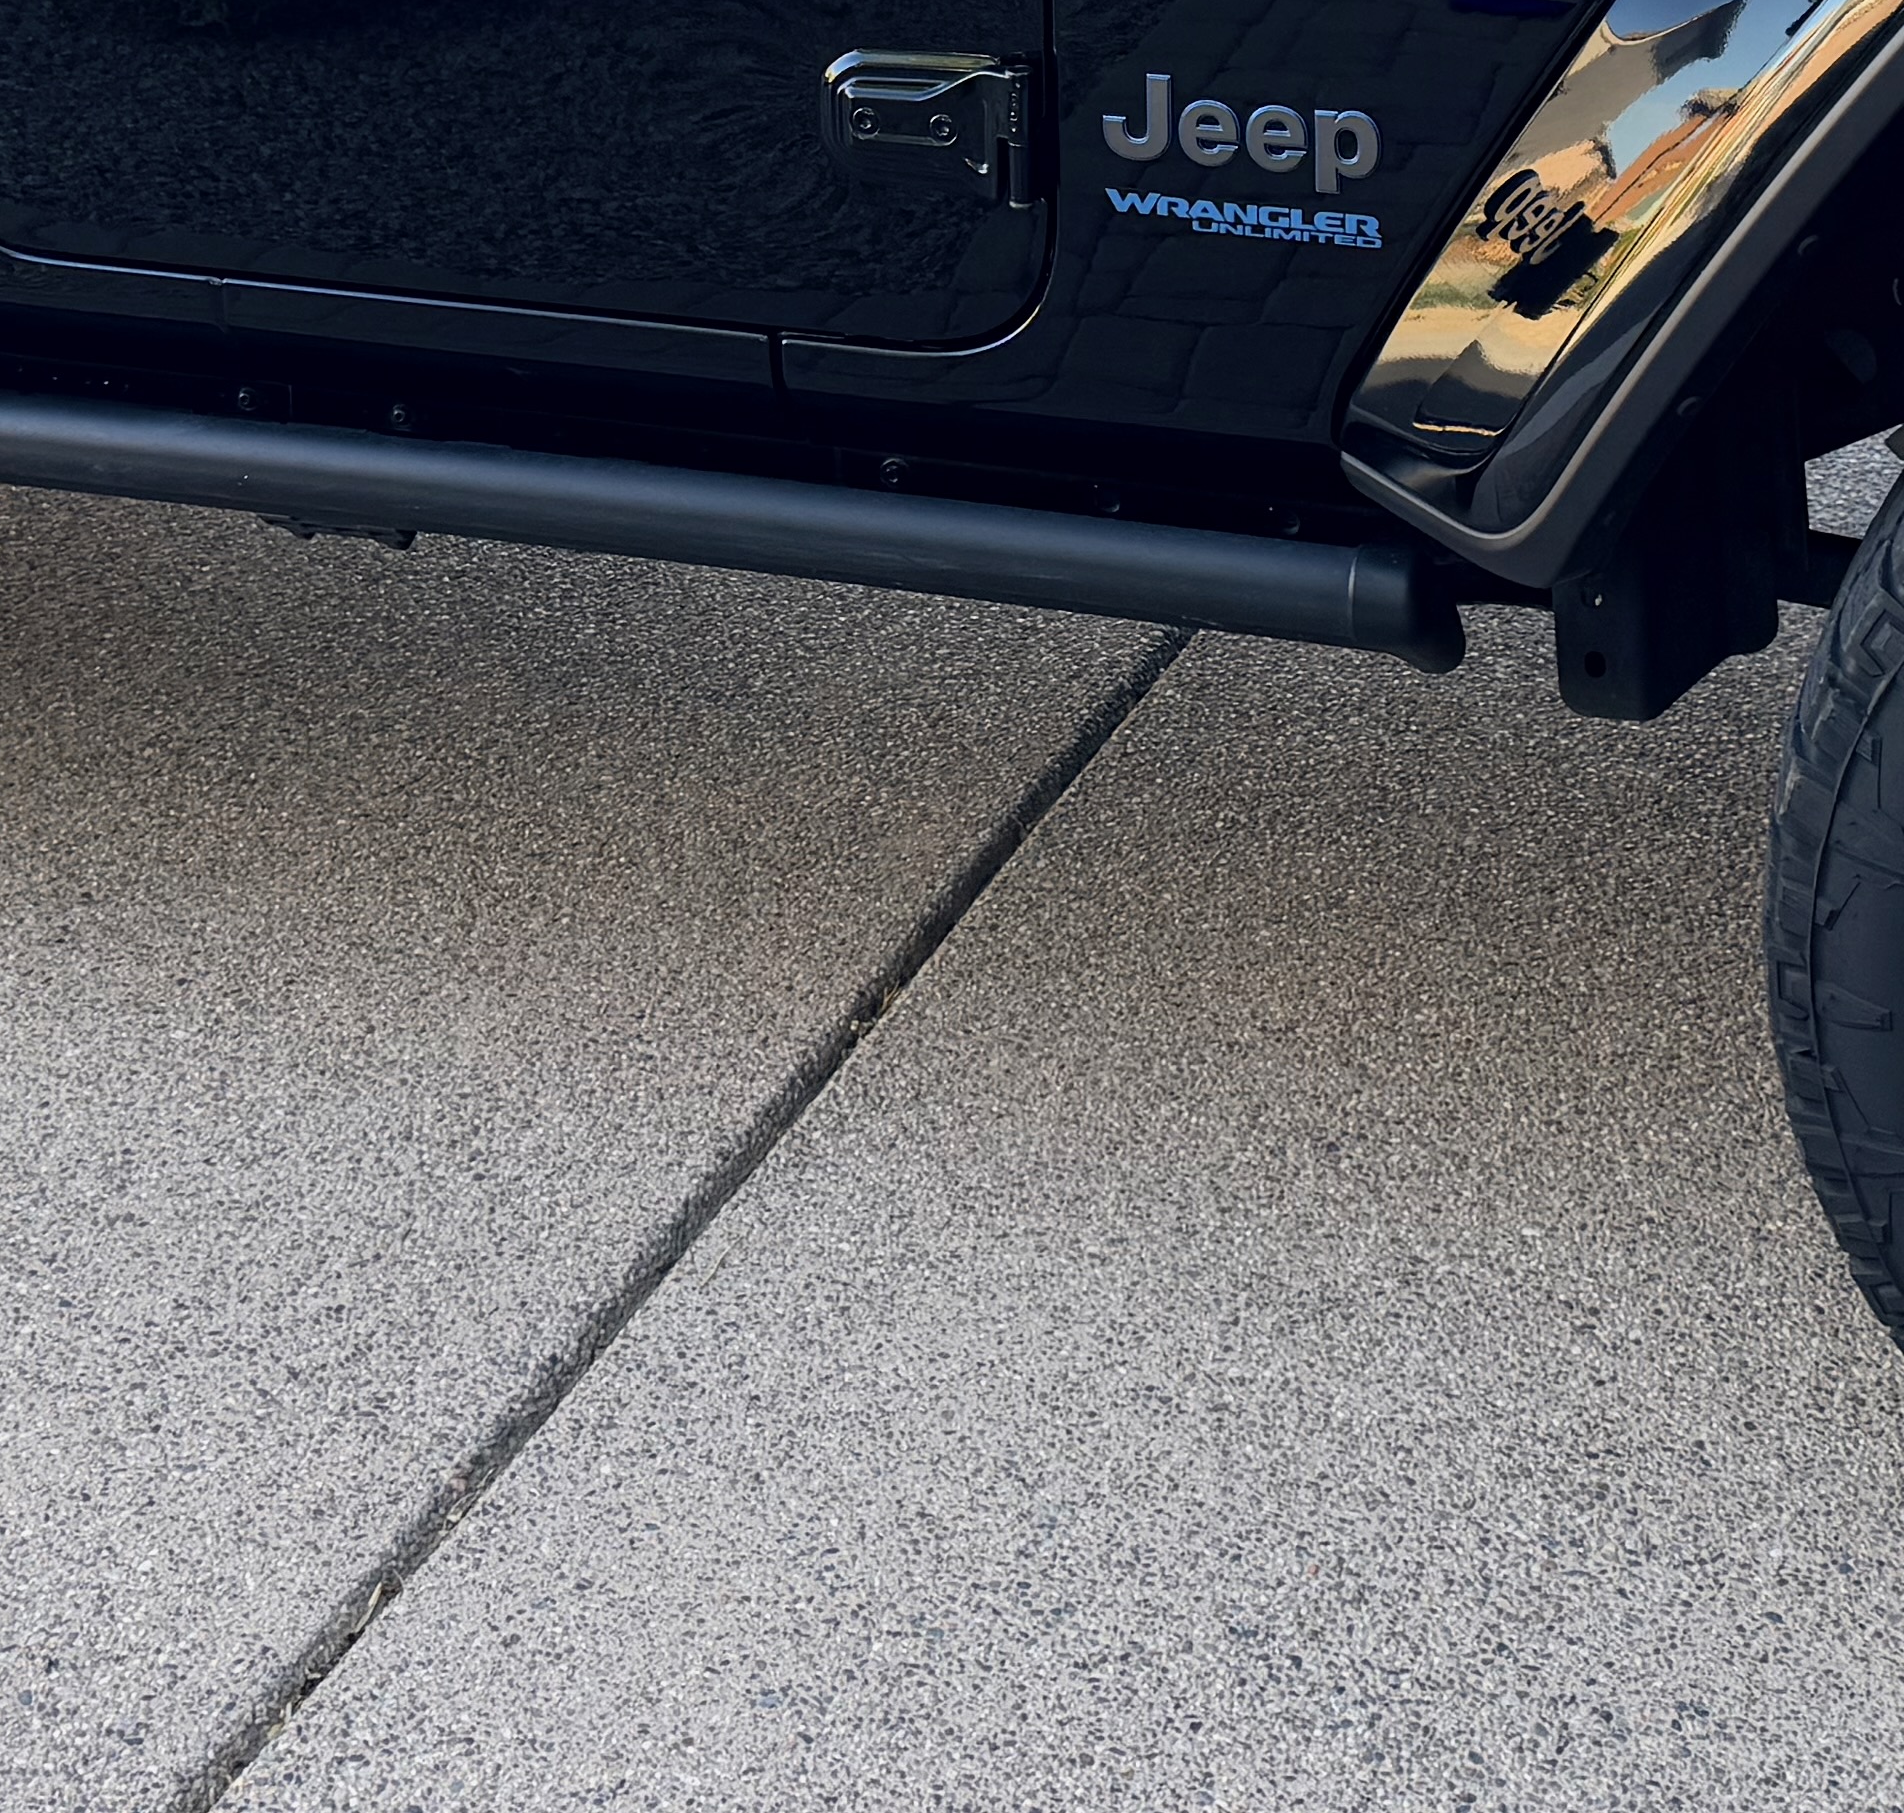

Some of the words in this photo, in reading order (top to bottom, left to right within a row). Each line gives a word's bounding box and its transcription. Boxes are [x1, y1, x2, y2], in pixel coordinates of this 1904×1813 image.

[1103, 73, 1382, 194] Jeep
[1105, 188, 1382, 237] WRANGLER
[1192, 220, 1382, 249] UNLIMITED
